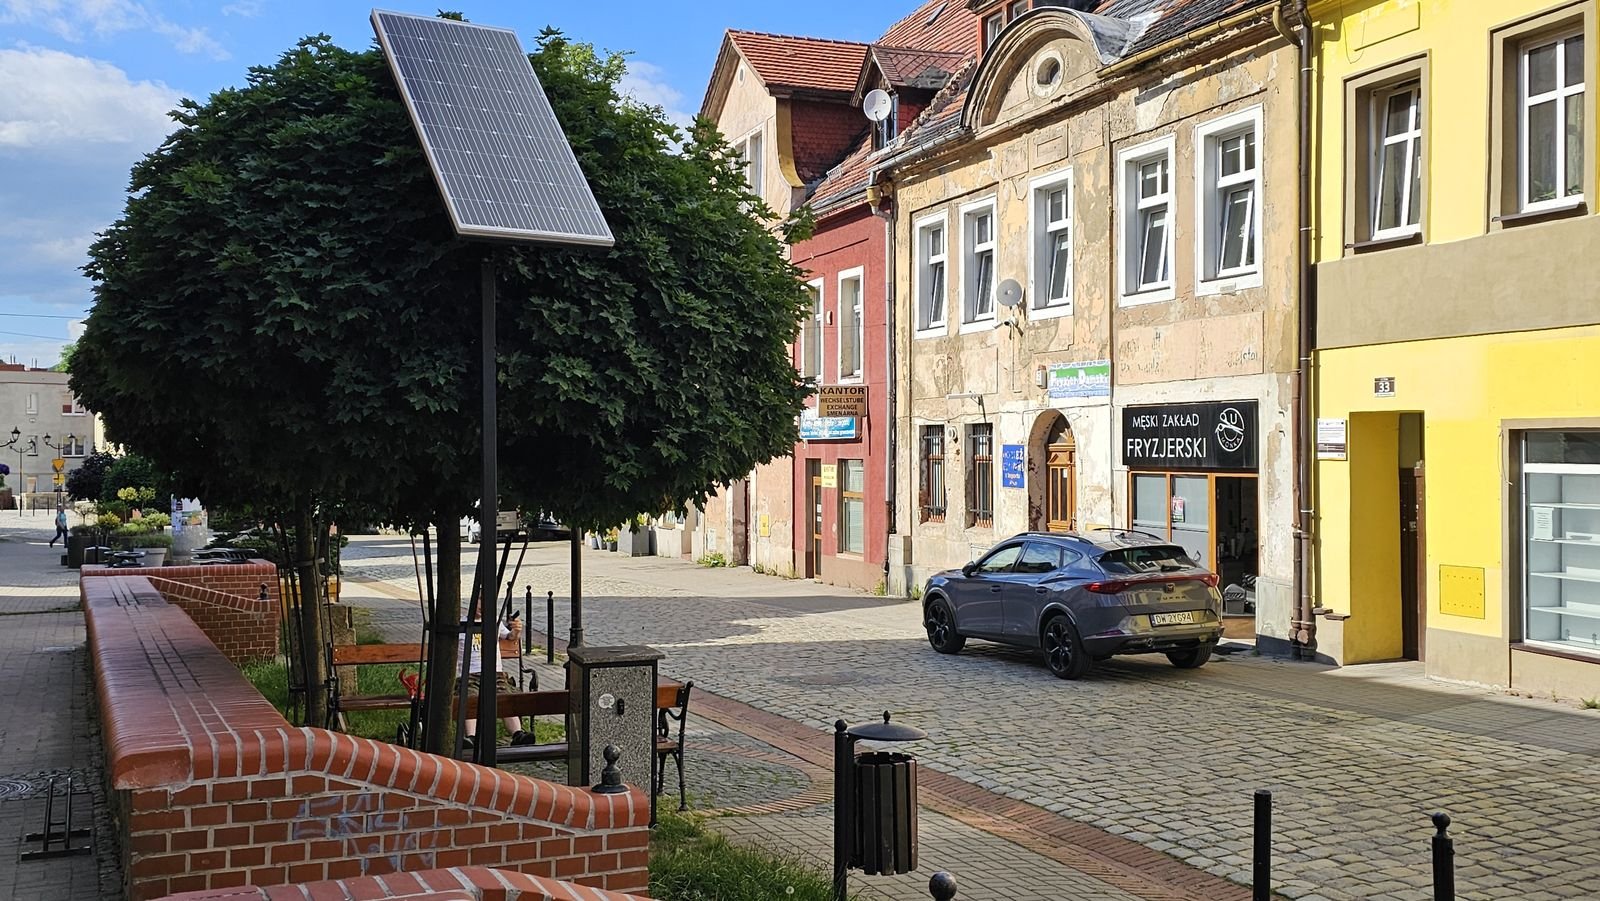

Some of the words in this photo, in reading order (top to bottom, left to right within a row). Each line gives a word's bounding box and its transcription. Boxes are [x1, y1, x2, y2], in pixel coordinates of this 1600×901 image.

[820, 387, 865, 395] KANTOR
[1379, 382, 1390, 393] 33
[1132, 415, 1158, 431] MĘSKI
[1162, 413, 1200, 427] ZAKŁAD
[1230, 413, 1238, 425] U
[1127, 437, 1207, 458] FRYZJERSKI
[1155, 614, 1167, 624] DW
